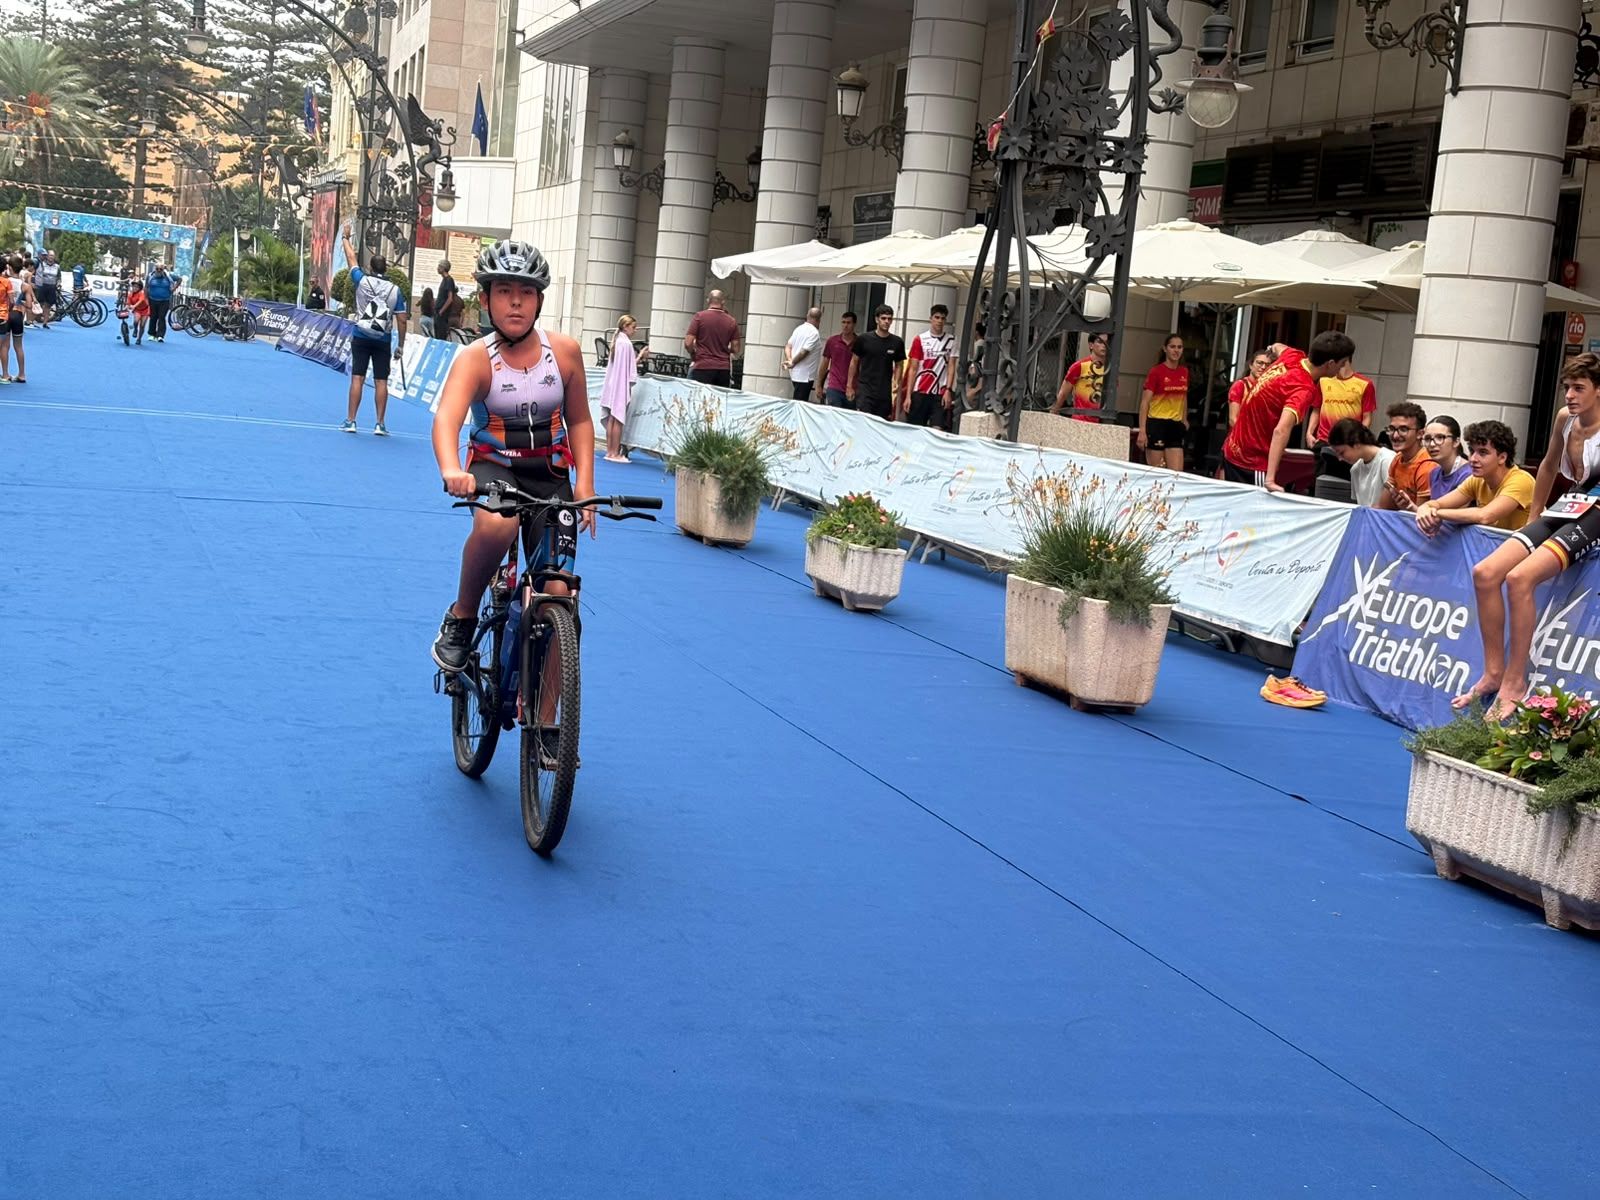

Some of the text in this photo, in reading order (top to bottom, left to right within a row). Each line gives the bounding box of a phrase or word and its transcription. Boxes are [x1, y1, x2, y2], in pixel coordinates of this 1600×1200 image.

[1568, 317, 1584, 334] ria
[515, 401, 538, 417] LEO
[1364, 577, 1469, 640] Europe
[1348, 621, 1471, 697] Triathlon
[1535, 619, 1600, 681] Eur
